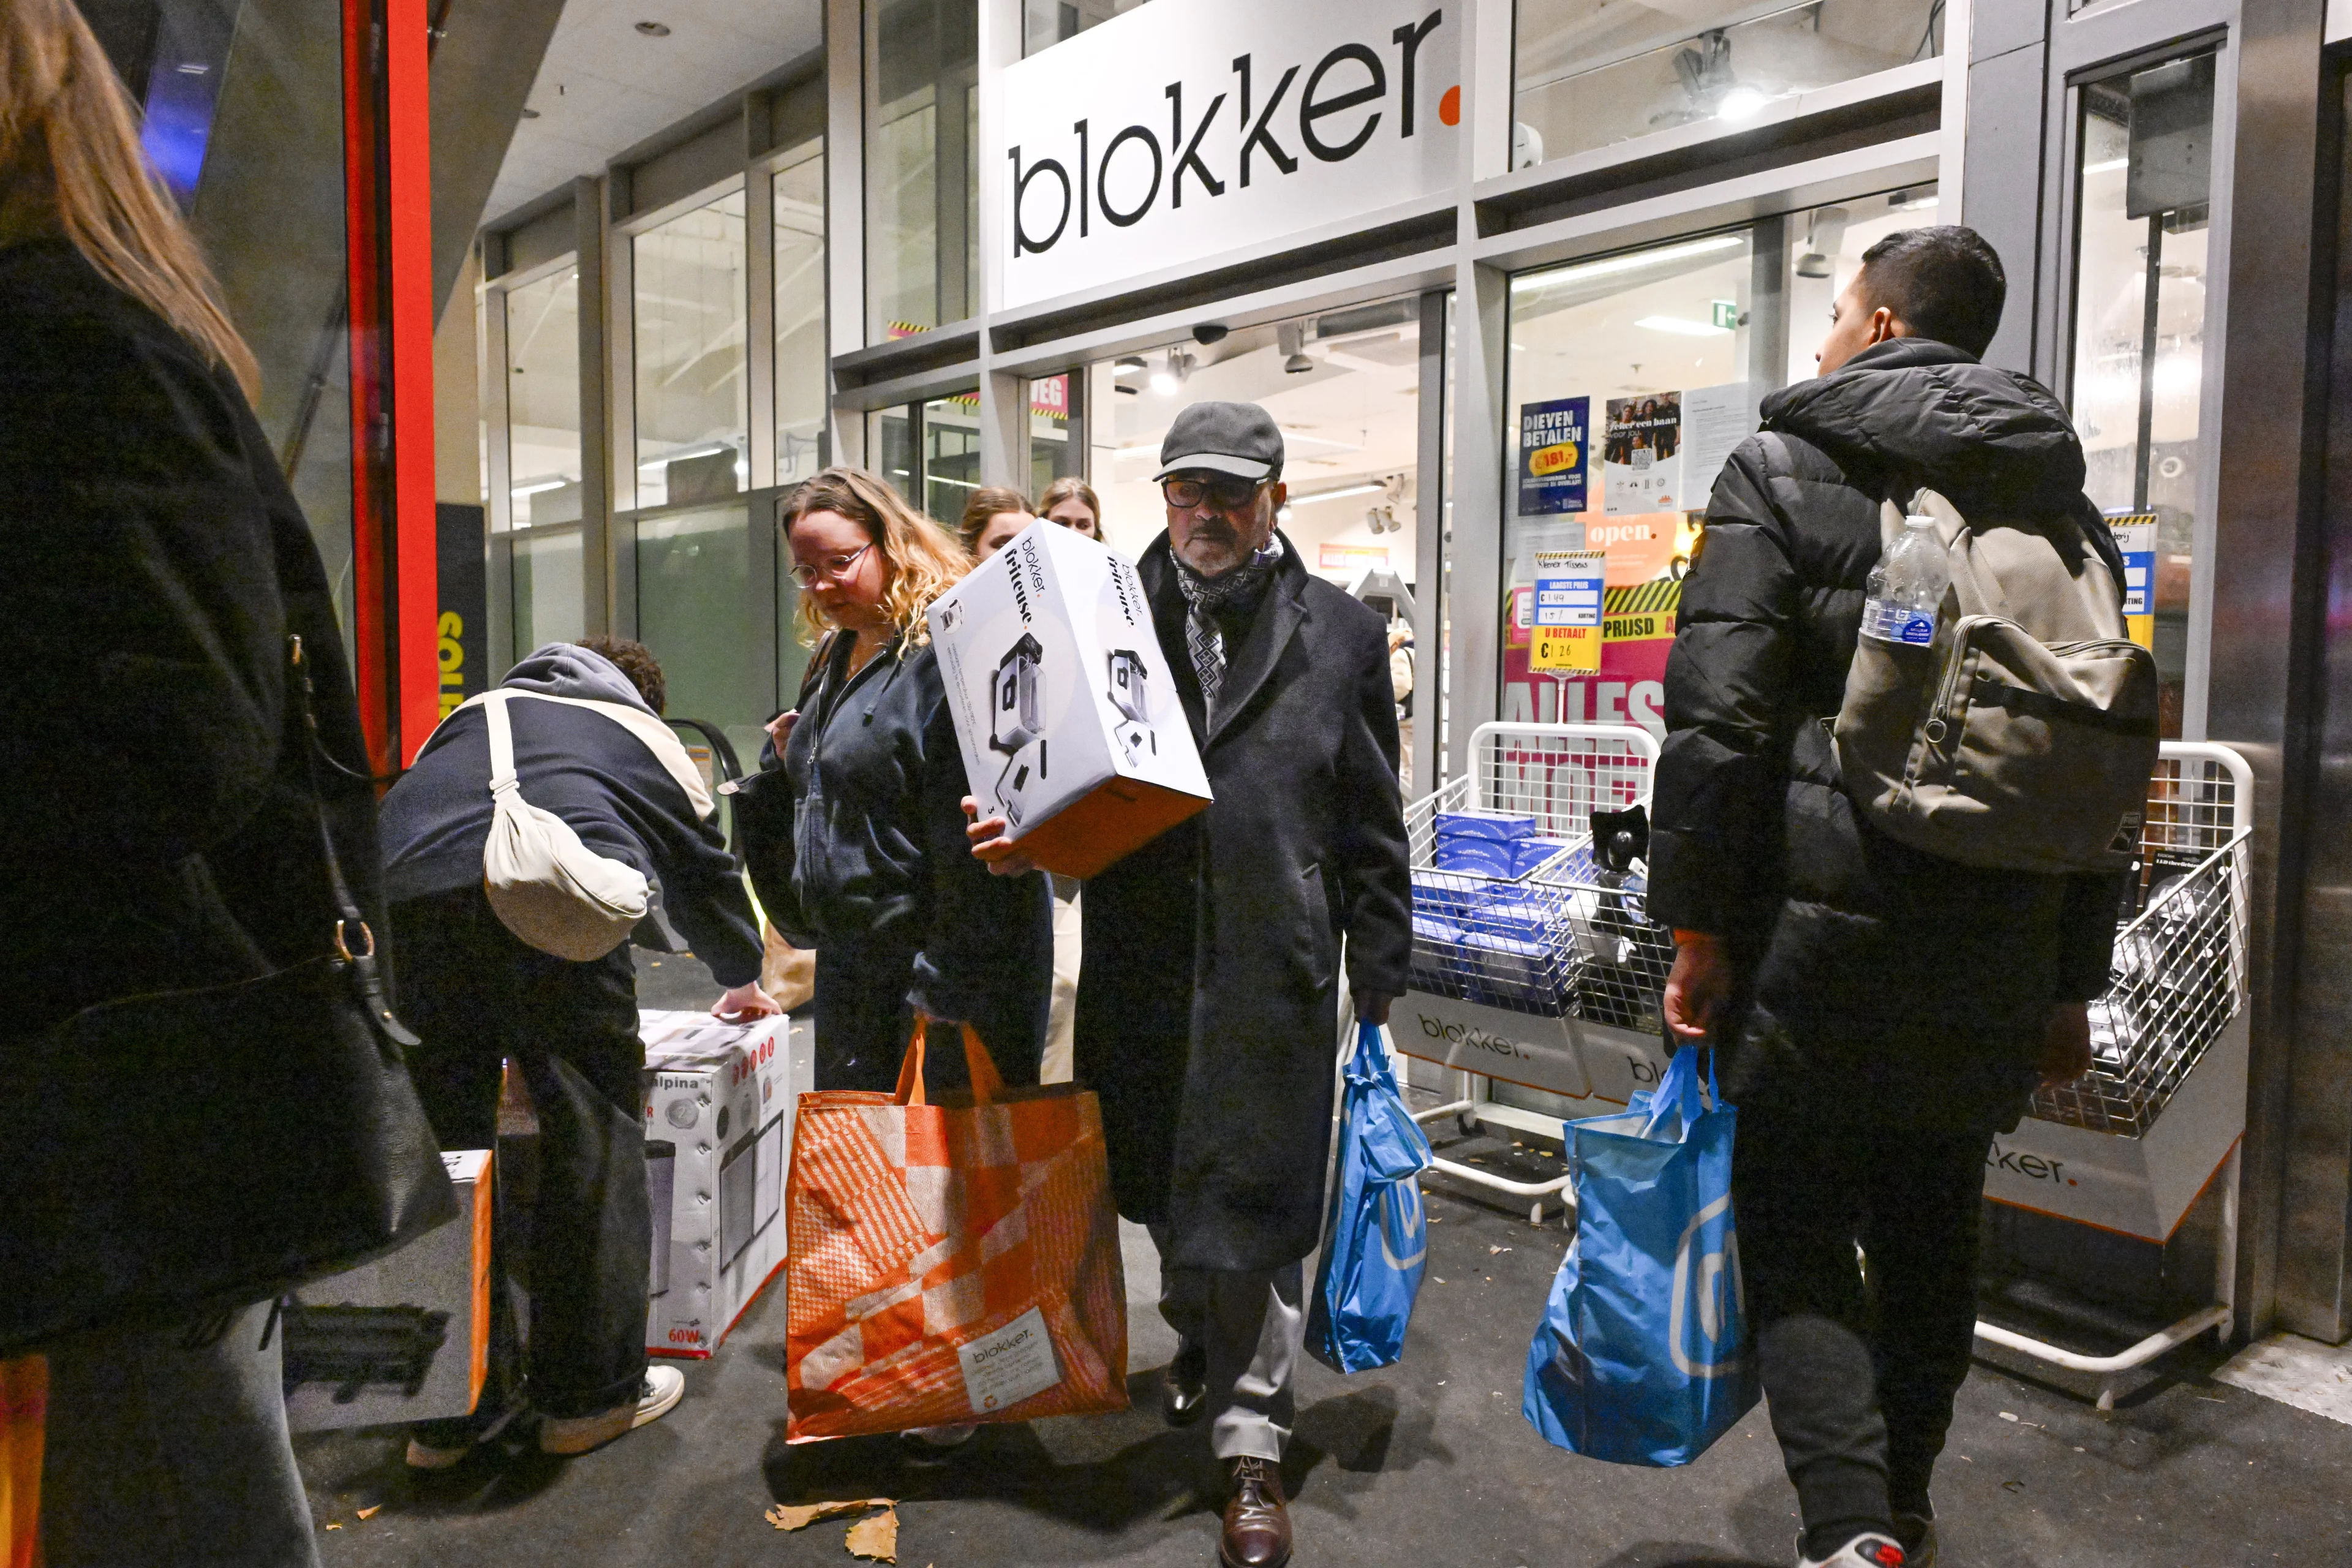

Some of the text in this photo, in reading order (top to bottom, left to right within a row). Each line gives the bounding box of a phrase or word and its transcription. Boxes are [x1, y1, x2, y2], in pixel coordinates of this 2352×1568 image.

[1008, 8, 1461, 258] blokker.
[1523, 410, 1574, 431] DIEVEN
[1654, 417, 1676, 426] baan
[1523, 426, 1581, 447] BETALEN
[1022, 537, 1046, 598] blokker.
[1545, 627, 1586, 638] U BETAALT
[669, 1328, 699, 1343] 60W
